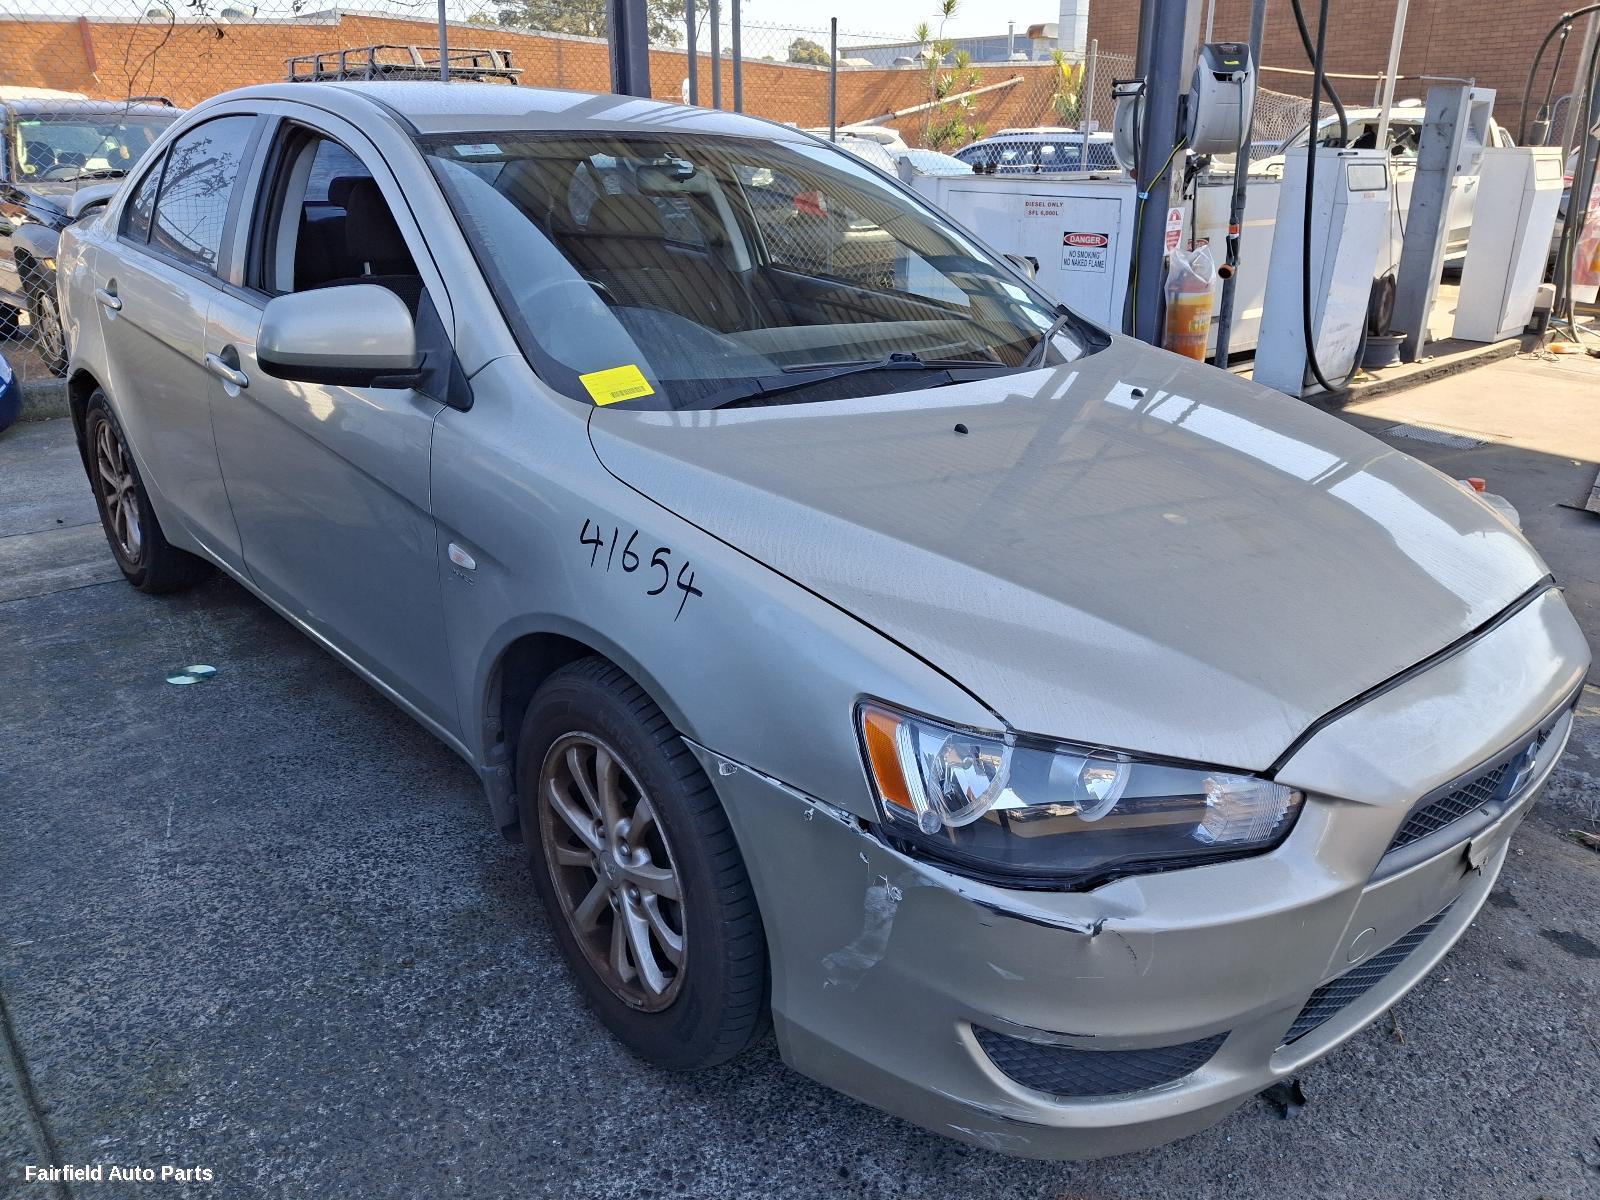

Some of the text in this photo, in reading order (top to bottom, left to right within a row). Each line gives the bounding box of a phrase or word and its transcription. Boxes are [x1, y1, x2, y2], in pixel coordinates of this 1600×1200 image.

[1069, 235, 1101, 245] DANGER
[1069, 250, 1100, 260] NO SMOKING
[1071, 259, 1088, 267] NAKED
[1088, 260, 1105, 269] FLAME
[580, 518, 703, 623] 41654
